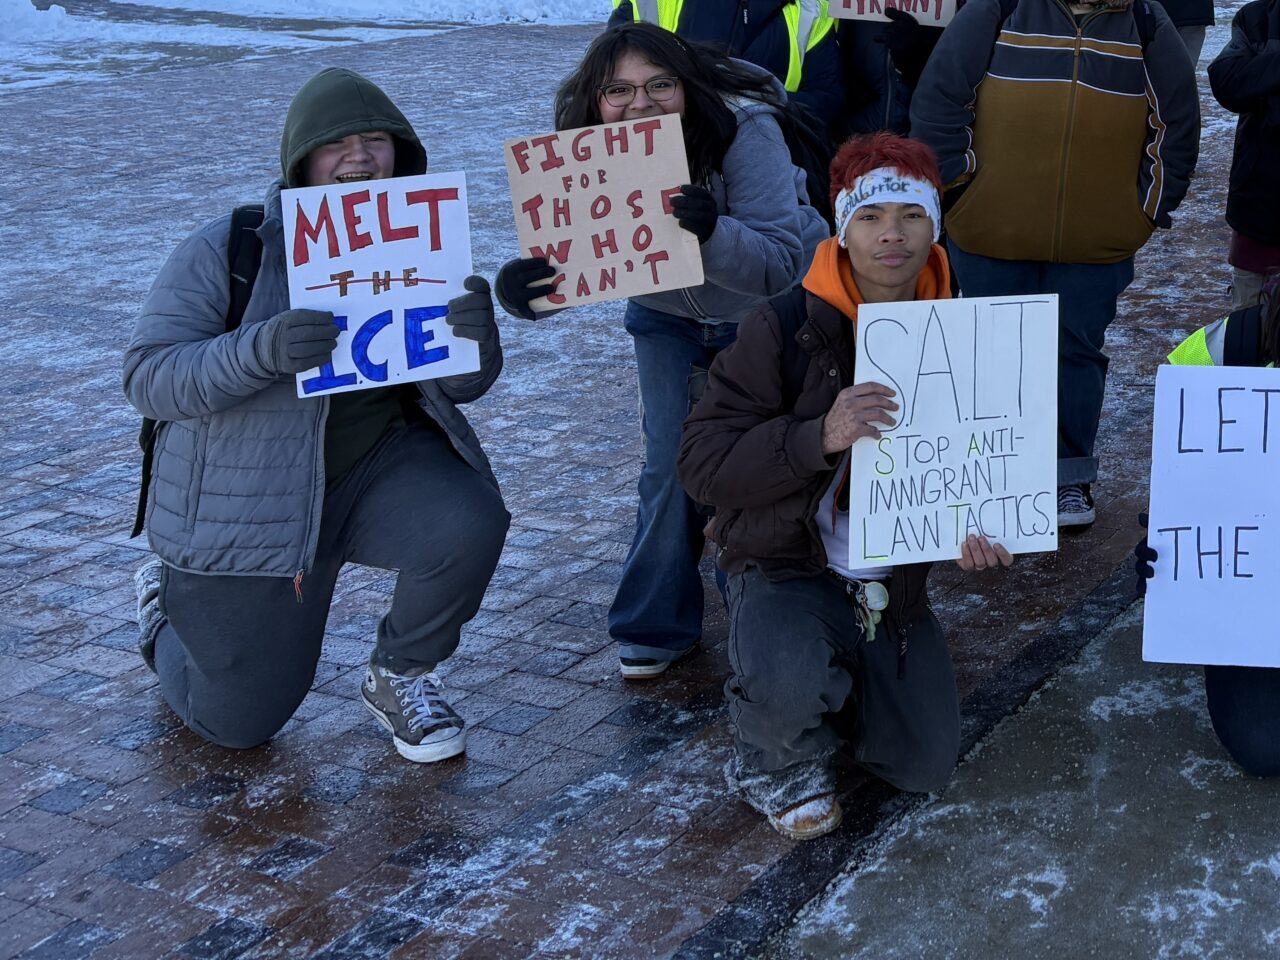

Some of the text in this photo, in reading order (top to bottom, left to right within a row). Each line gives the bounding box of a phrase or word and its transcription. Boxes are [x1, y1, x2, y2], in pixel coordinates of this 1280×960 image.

[511, 119, 661, 174] FIGHT
[561, 169, 607, 192] FOR
[293, 187, 459, 267] MELT
[529, 224, 653, 265] WHO
[329, 267, 418, 297] THE
[547, 250, 669, 304] CAN'T
[875, 426, 1025, 475] STOP ANTI-
[869, 454, 1018, 515] IMMIGRANT
[863, 510, 940, 560] LAW
[1158, 526, 1259, 580] THE
